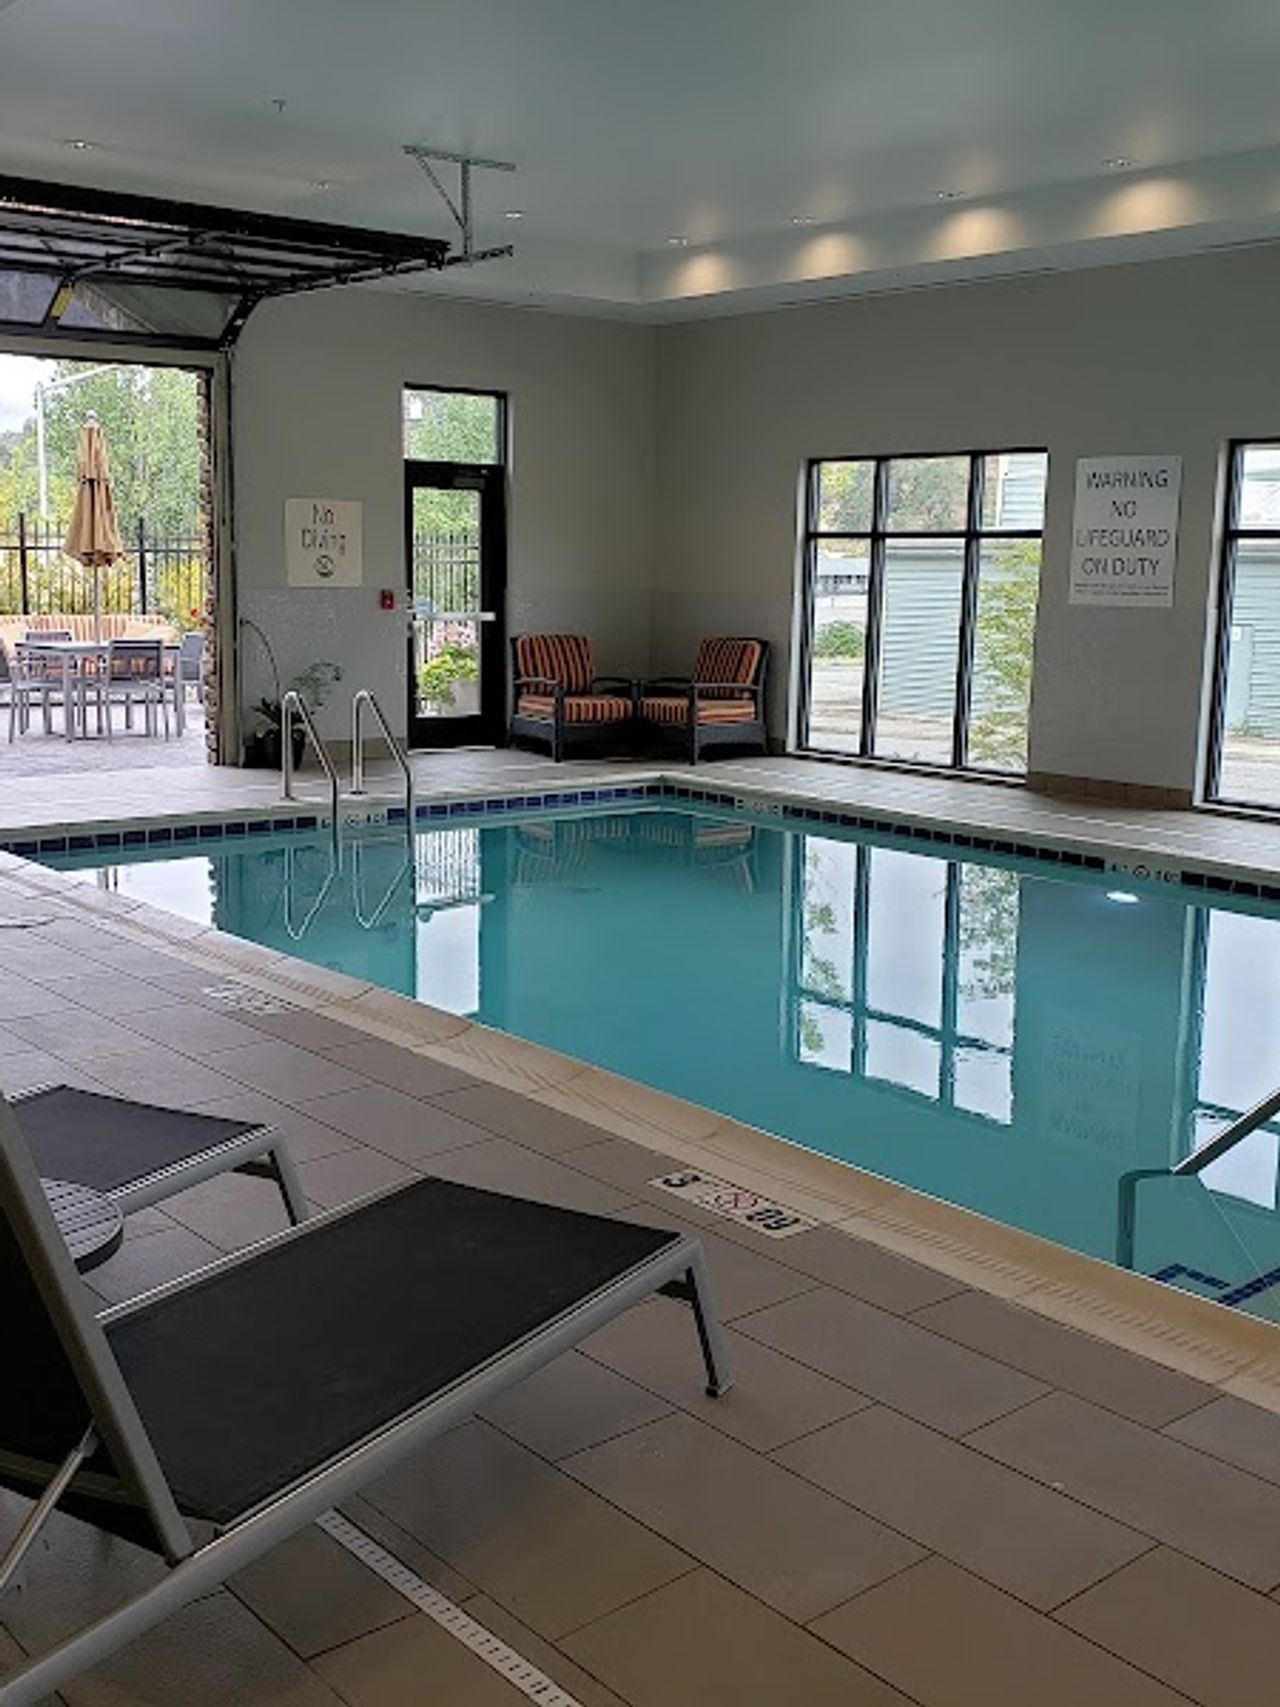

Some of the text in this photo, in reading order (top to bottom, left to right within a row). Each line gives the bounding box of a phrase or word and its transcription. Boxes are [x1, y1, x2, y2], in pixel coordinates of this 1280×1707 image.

[1086, 469, 1169, 489] WARNING
[312, 503, 335, 525] No
[1109, 500, 1138, 519] NO
[301, 528, 346, 557] Diving
[1076, 528, 1170, 547] LIFEGUARD
[1081, 557, 1161, 576] ON DUTY
